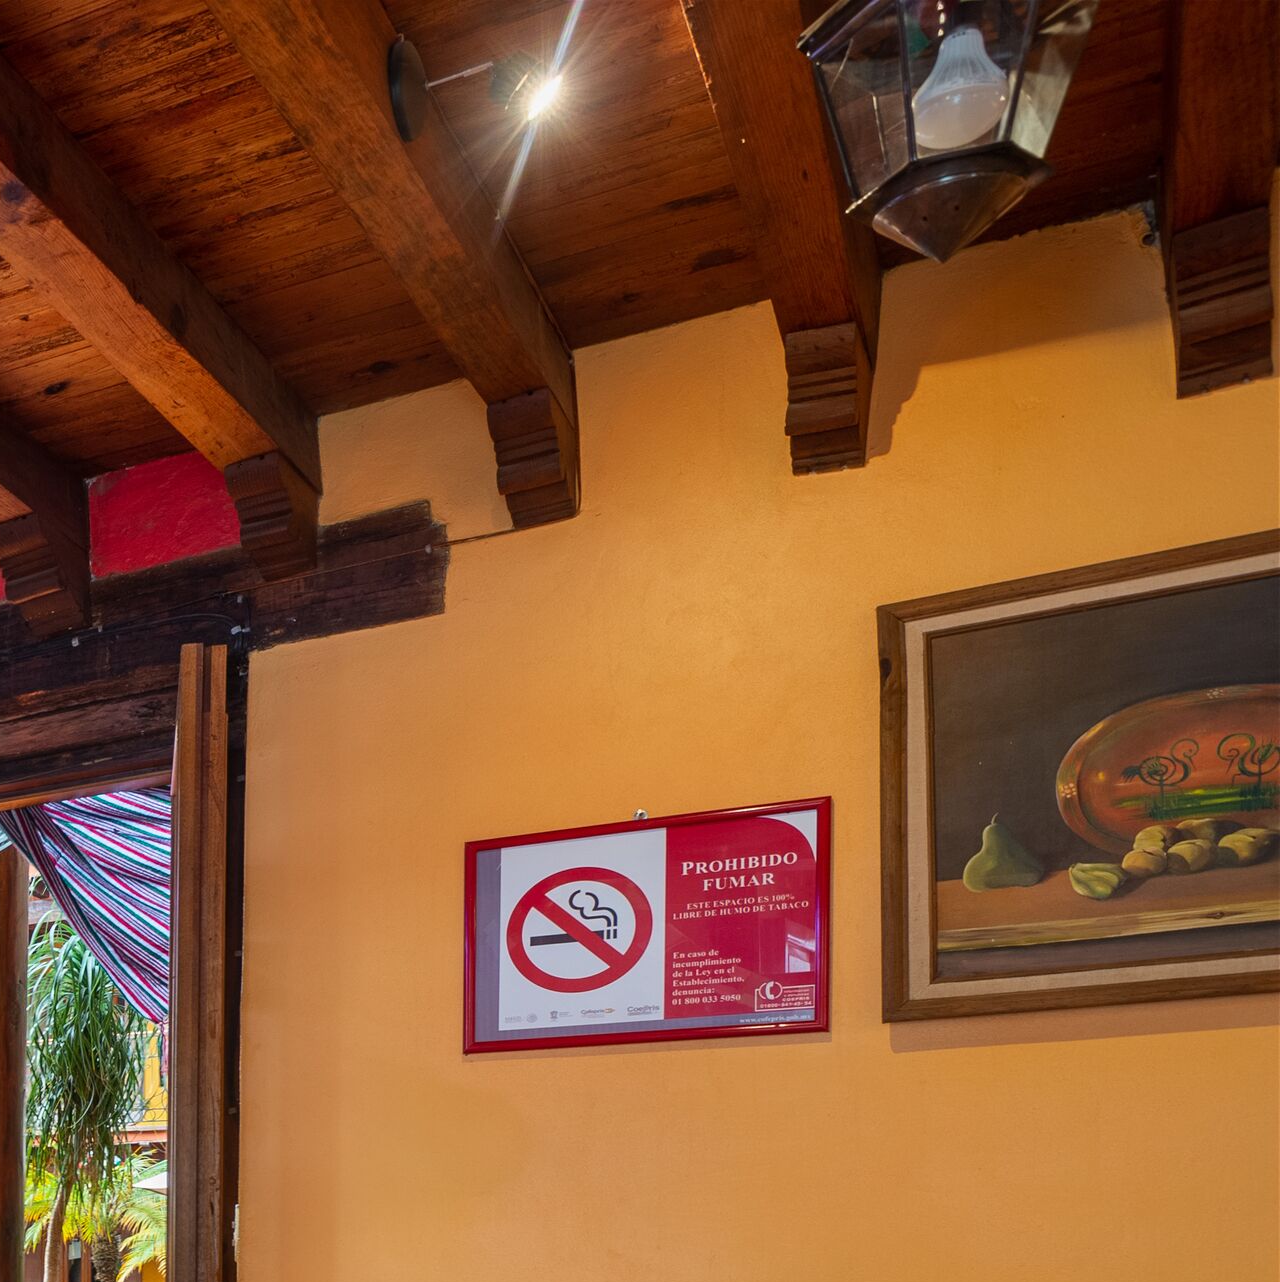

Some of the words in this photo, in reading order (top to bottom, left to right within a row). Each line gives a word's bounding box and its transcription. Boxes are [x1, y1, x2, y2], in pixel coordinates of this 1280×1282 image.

[682, 852, 797, 876] PROHIBIDO
[703, 873, 775, 891] FUMAR
[687, 902, 713, 910] ESTE
[713, 897, 755, 907] ESPACIO
[772, 894, 795, 902] 100%
[673, 912, 702, 920] LIBRE
[705, 909, 717, 917] DE
[720, 907, 750, 916] HUMO
[769, 901, 809, 911] TABACO
[672, 958, 741, 968] incumplimiento
[672, 970, 683, 978] de
[696, 969, 710, 977] Ley
[672, 976, 744, 987] Establecimiento,
[672, 987, 715, 996] denuncia:
[720, 994, 740, 1002] 5050
